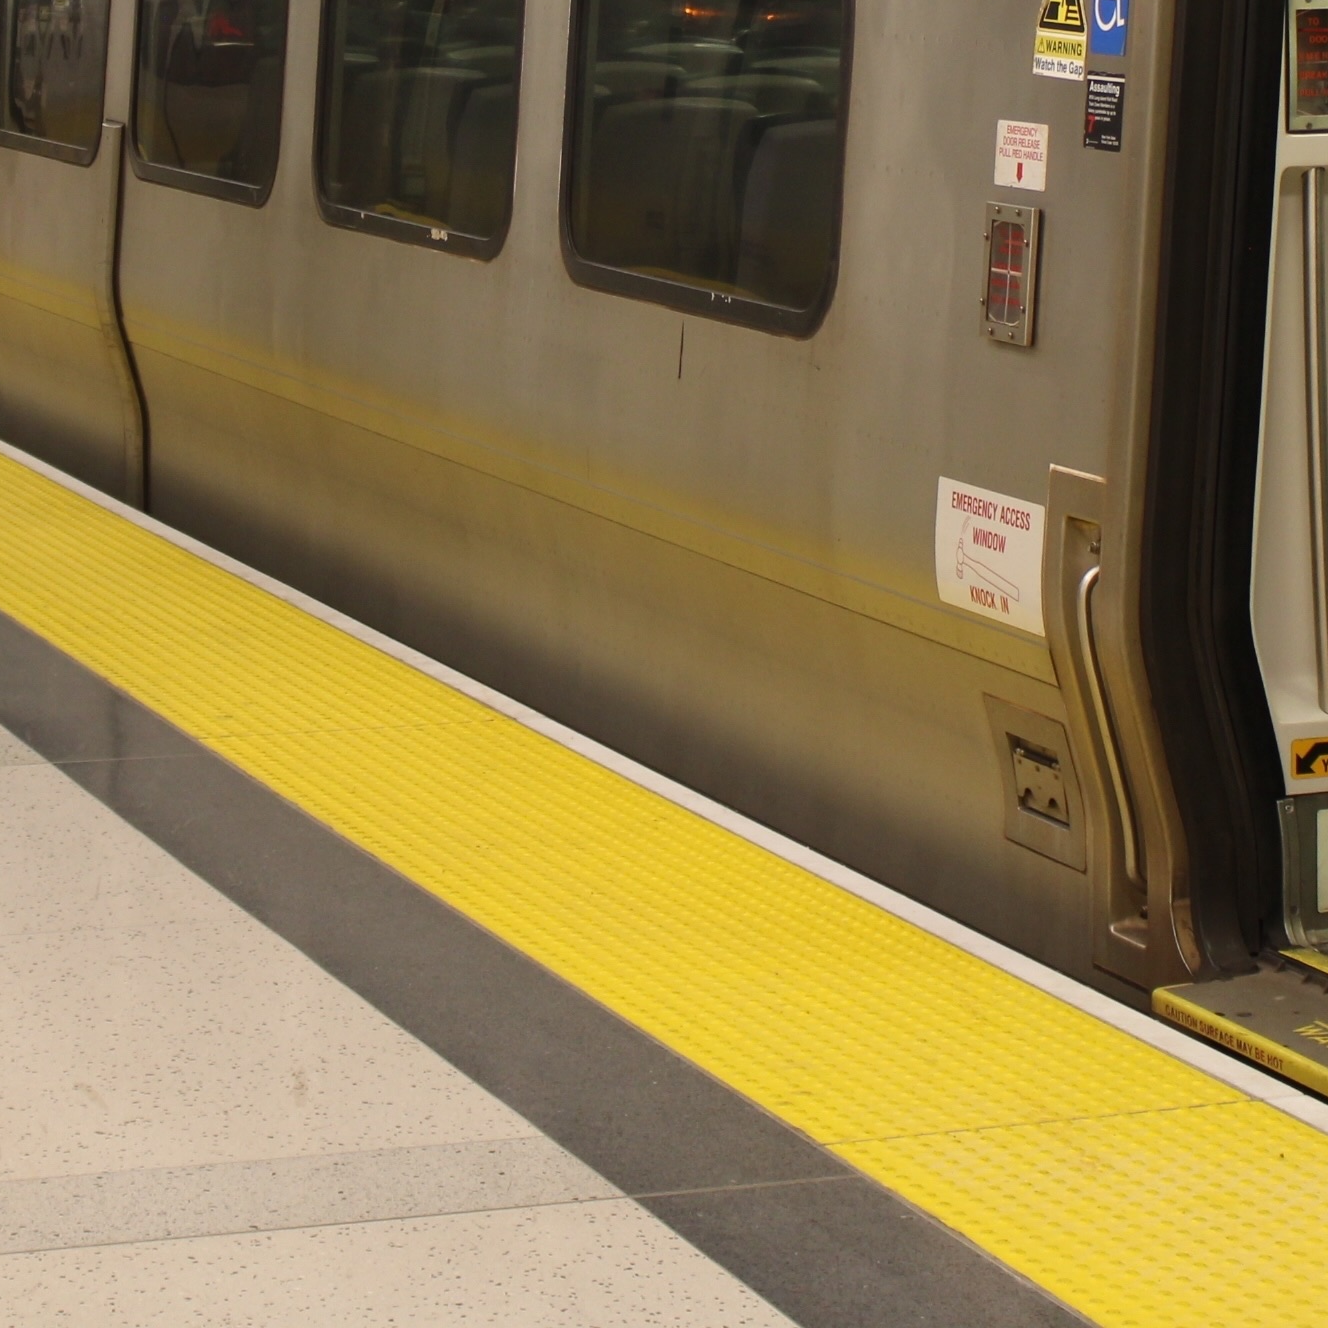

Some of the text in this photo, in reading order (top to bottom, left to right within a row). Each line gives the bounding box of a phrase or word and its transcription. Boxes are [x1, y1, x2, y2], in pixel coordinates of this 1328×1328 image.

[1045, 40, 1082, 57] WARNING
[1034, 57, 1083, 78] Watch the Gap
[1089, 80, 1121, 98] Assaulting
[1007, 125, 1039, 138] EMERGENCY
[1003, 135, 1041, 149] DOOR RELEASE
[999, 147, 1044, 162] PULL RED HANDLE
[951, 491, 1031, 531] EMERGENCY ACCESS
[972, 526, 1007, 554] WINDOW
[969, 584, 1010, 615] KNOCK IN
[1165, 1004, 1284, 1071] CAUTION SURFACE MAY BE HOT
